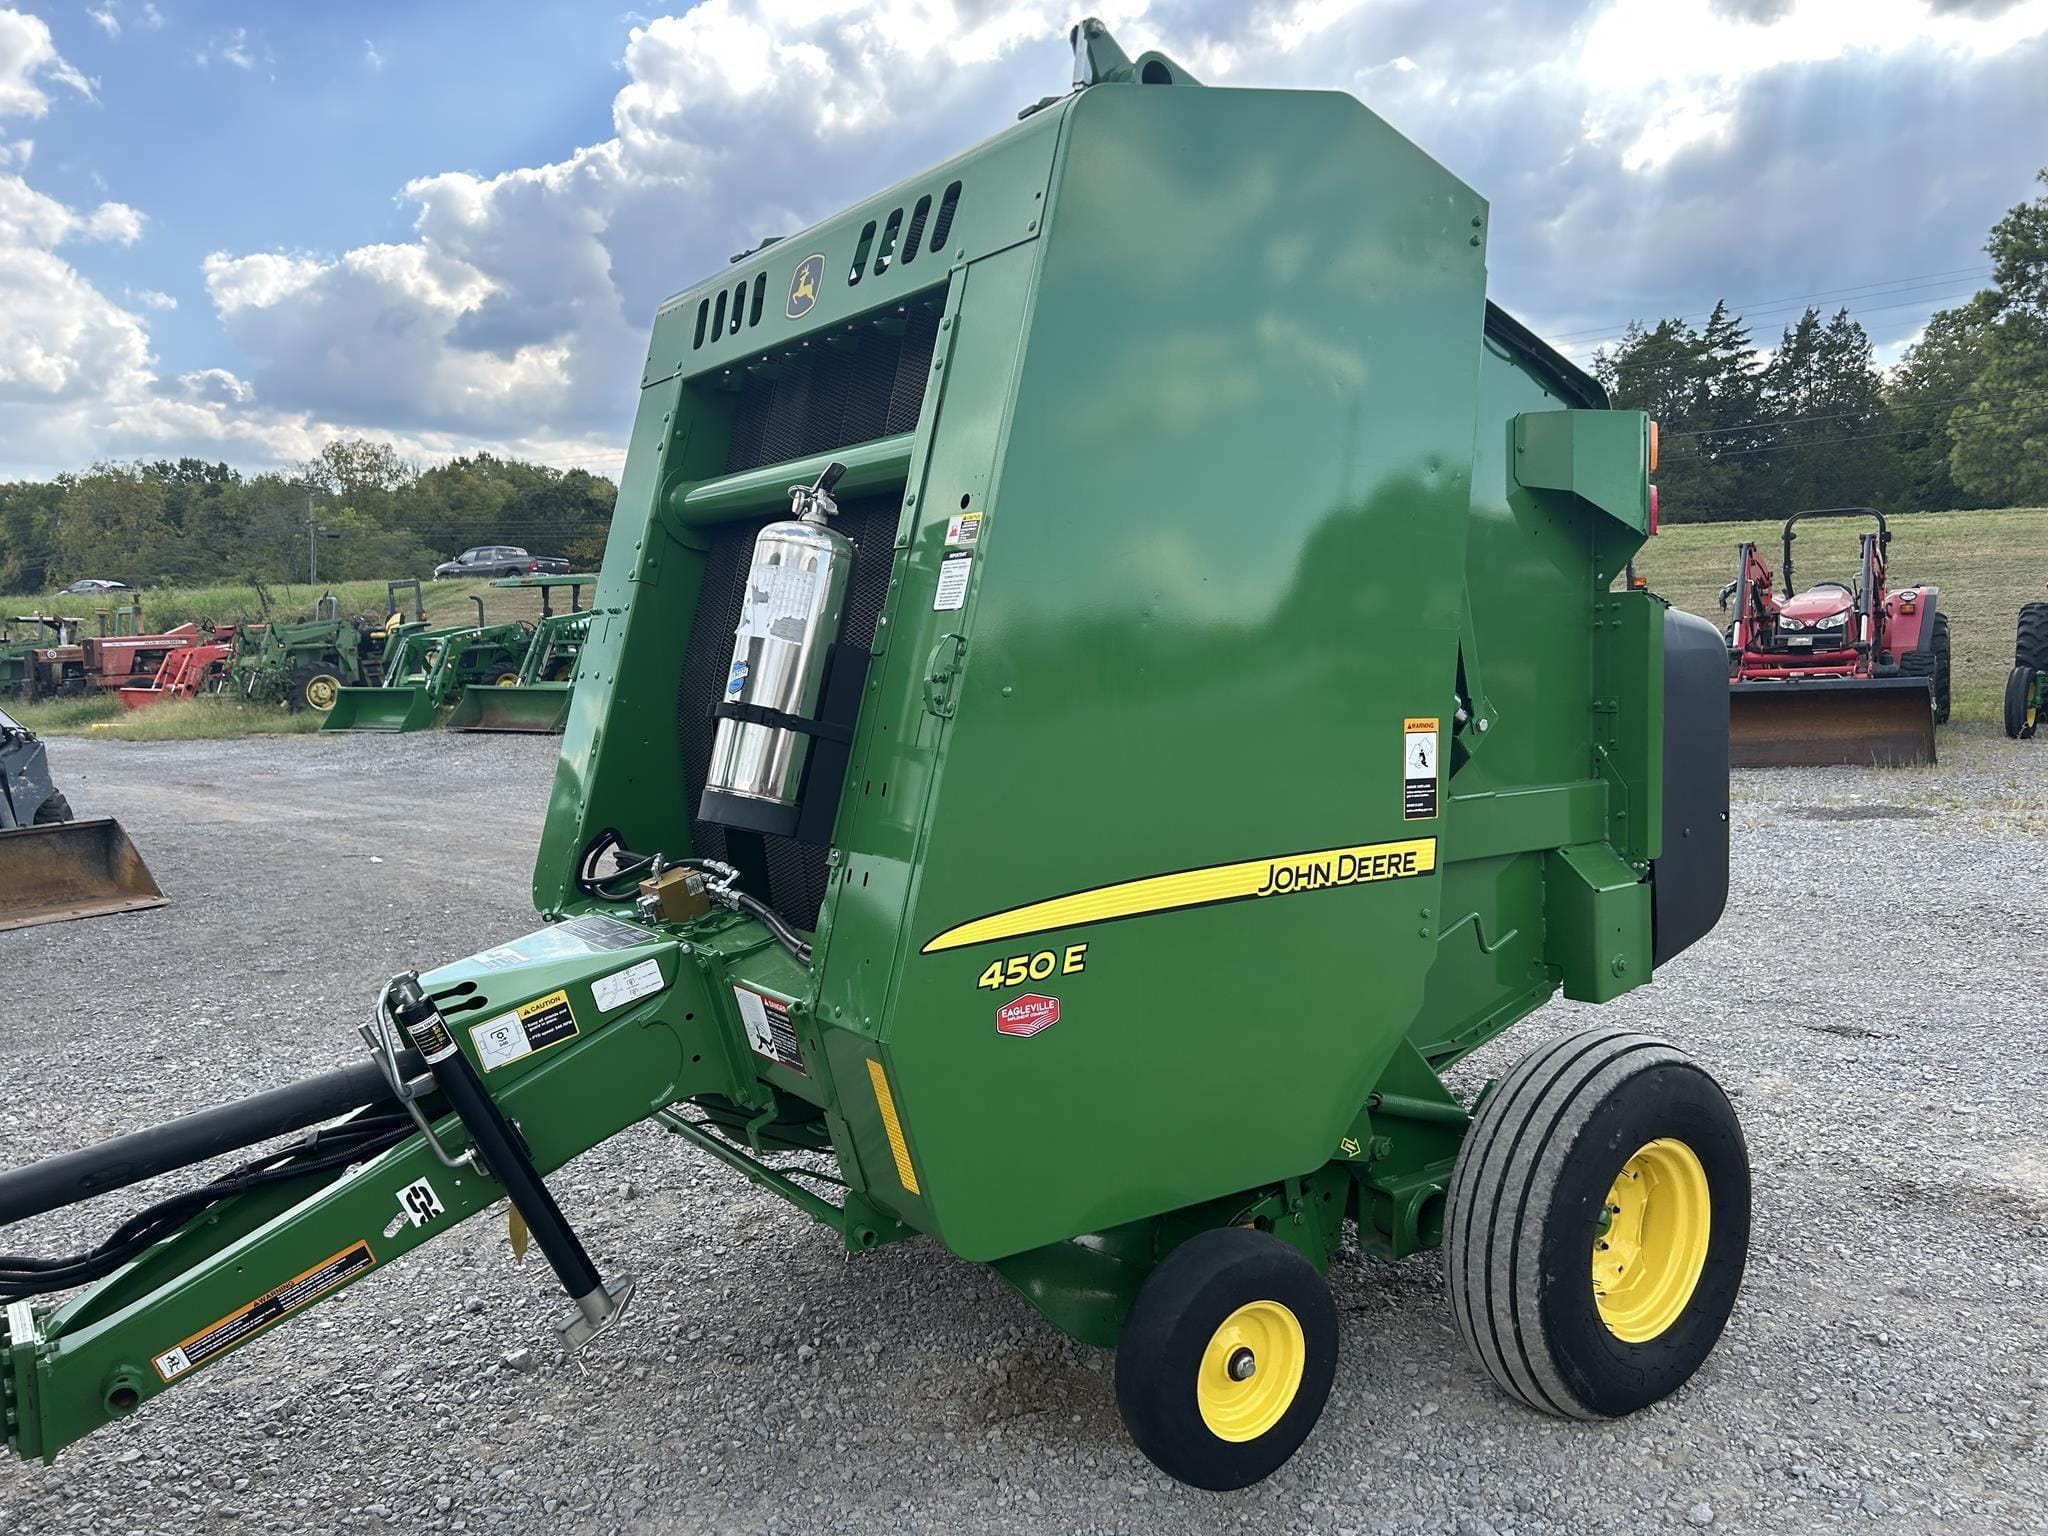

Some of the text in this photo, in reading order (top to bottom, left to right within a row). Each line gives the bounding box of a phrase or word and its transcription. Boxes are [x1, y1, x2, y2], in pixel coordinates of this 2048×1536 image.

[1258, 852, 1417, 893] JOHN DEERE
[977, 943, 1088, 990] 450 E
[530, 996, 561, 1012] CAUTION
[1001, 1000, 1055, 1018] EAGLEVILLE
[258, 1281, 294, 1304] WARNING
